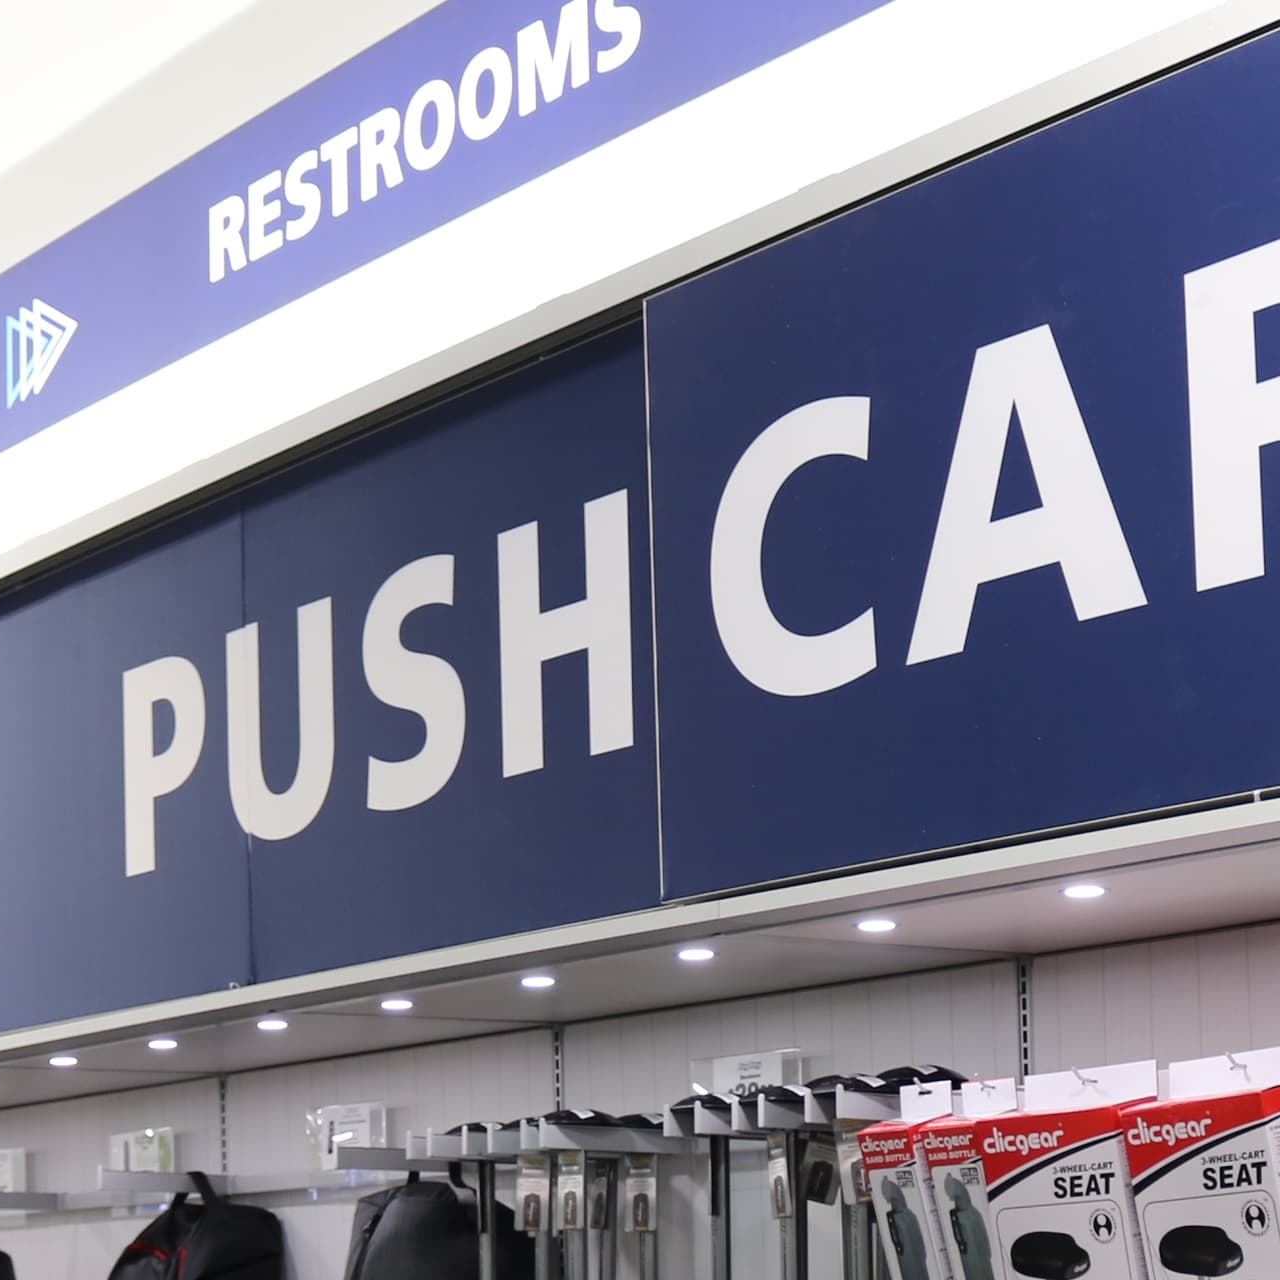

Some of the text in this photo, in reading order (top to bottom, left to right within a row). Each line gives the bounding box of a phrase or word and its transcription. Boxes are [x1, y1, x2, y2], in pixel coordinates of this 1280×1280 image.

[209, 0, 642, 283] RESTROOMS
[121, 488, 634, 877] PUSH
[861, 1133, 908, 1153] clicgear
[924, 1132, 973, 1150] clicgear
[983, 1127, 1064, 1156] clicgear
[1127, 1117, 1212, 1146] clicgear
[928, 1149, 976, 1161] SAND BOTTLE
[1201, 1150, 1265, 1166] 3-WHEEL-CART
[1053, 1162, 1113, 1175] 3-WHEEL-CART
[1202, 1161, 1267, 1190] SEAT
[1053, 1173, 1115, 1199] SEAT
